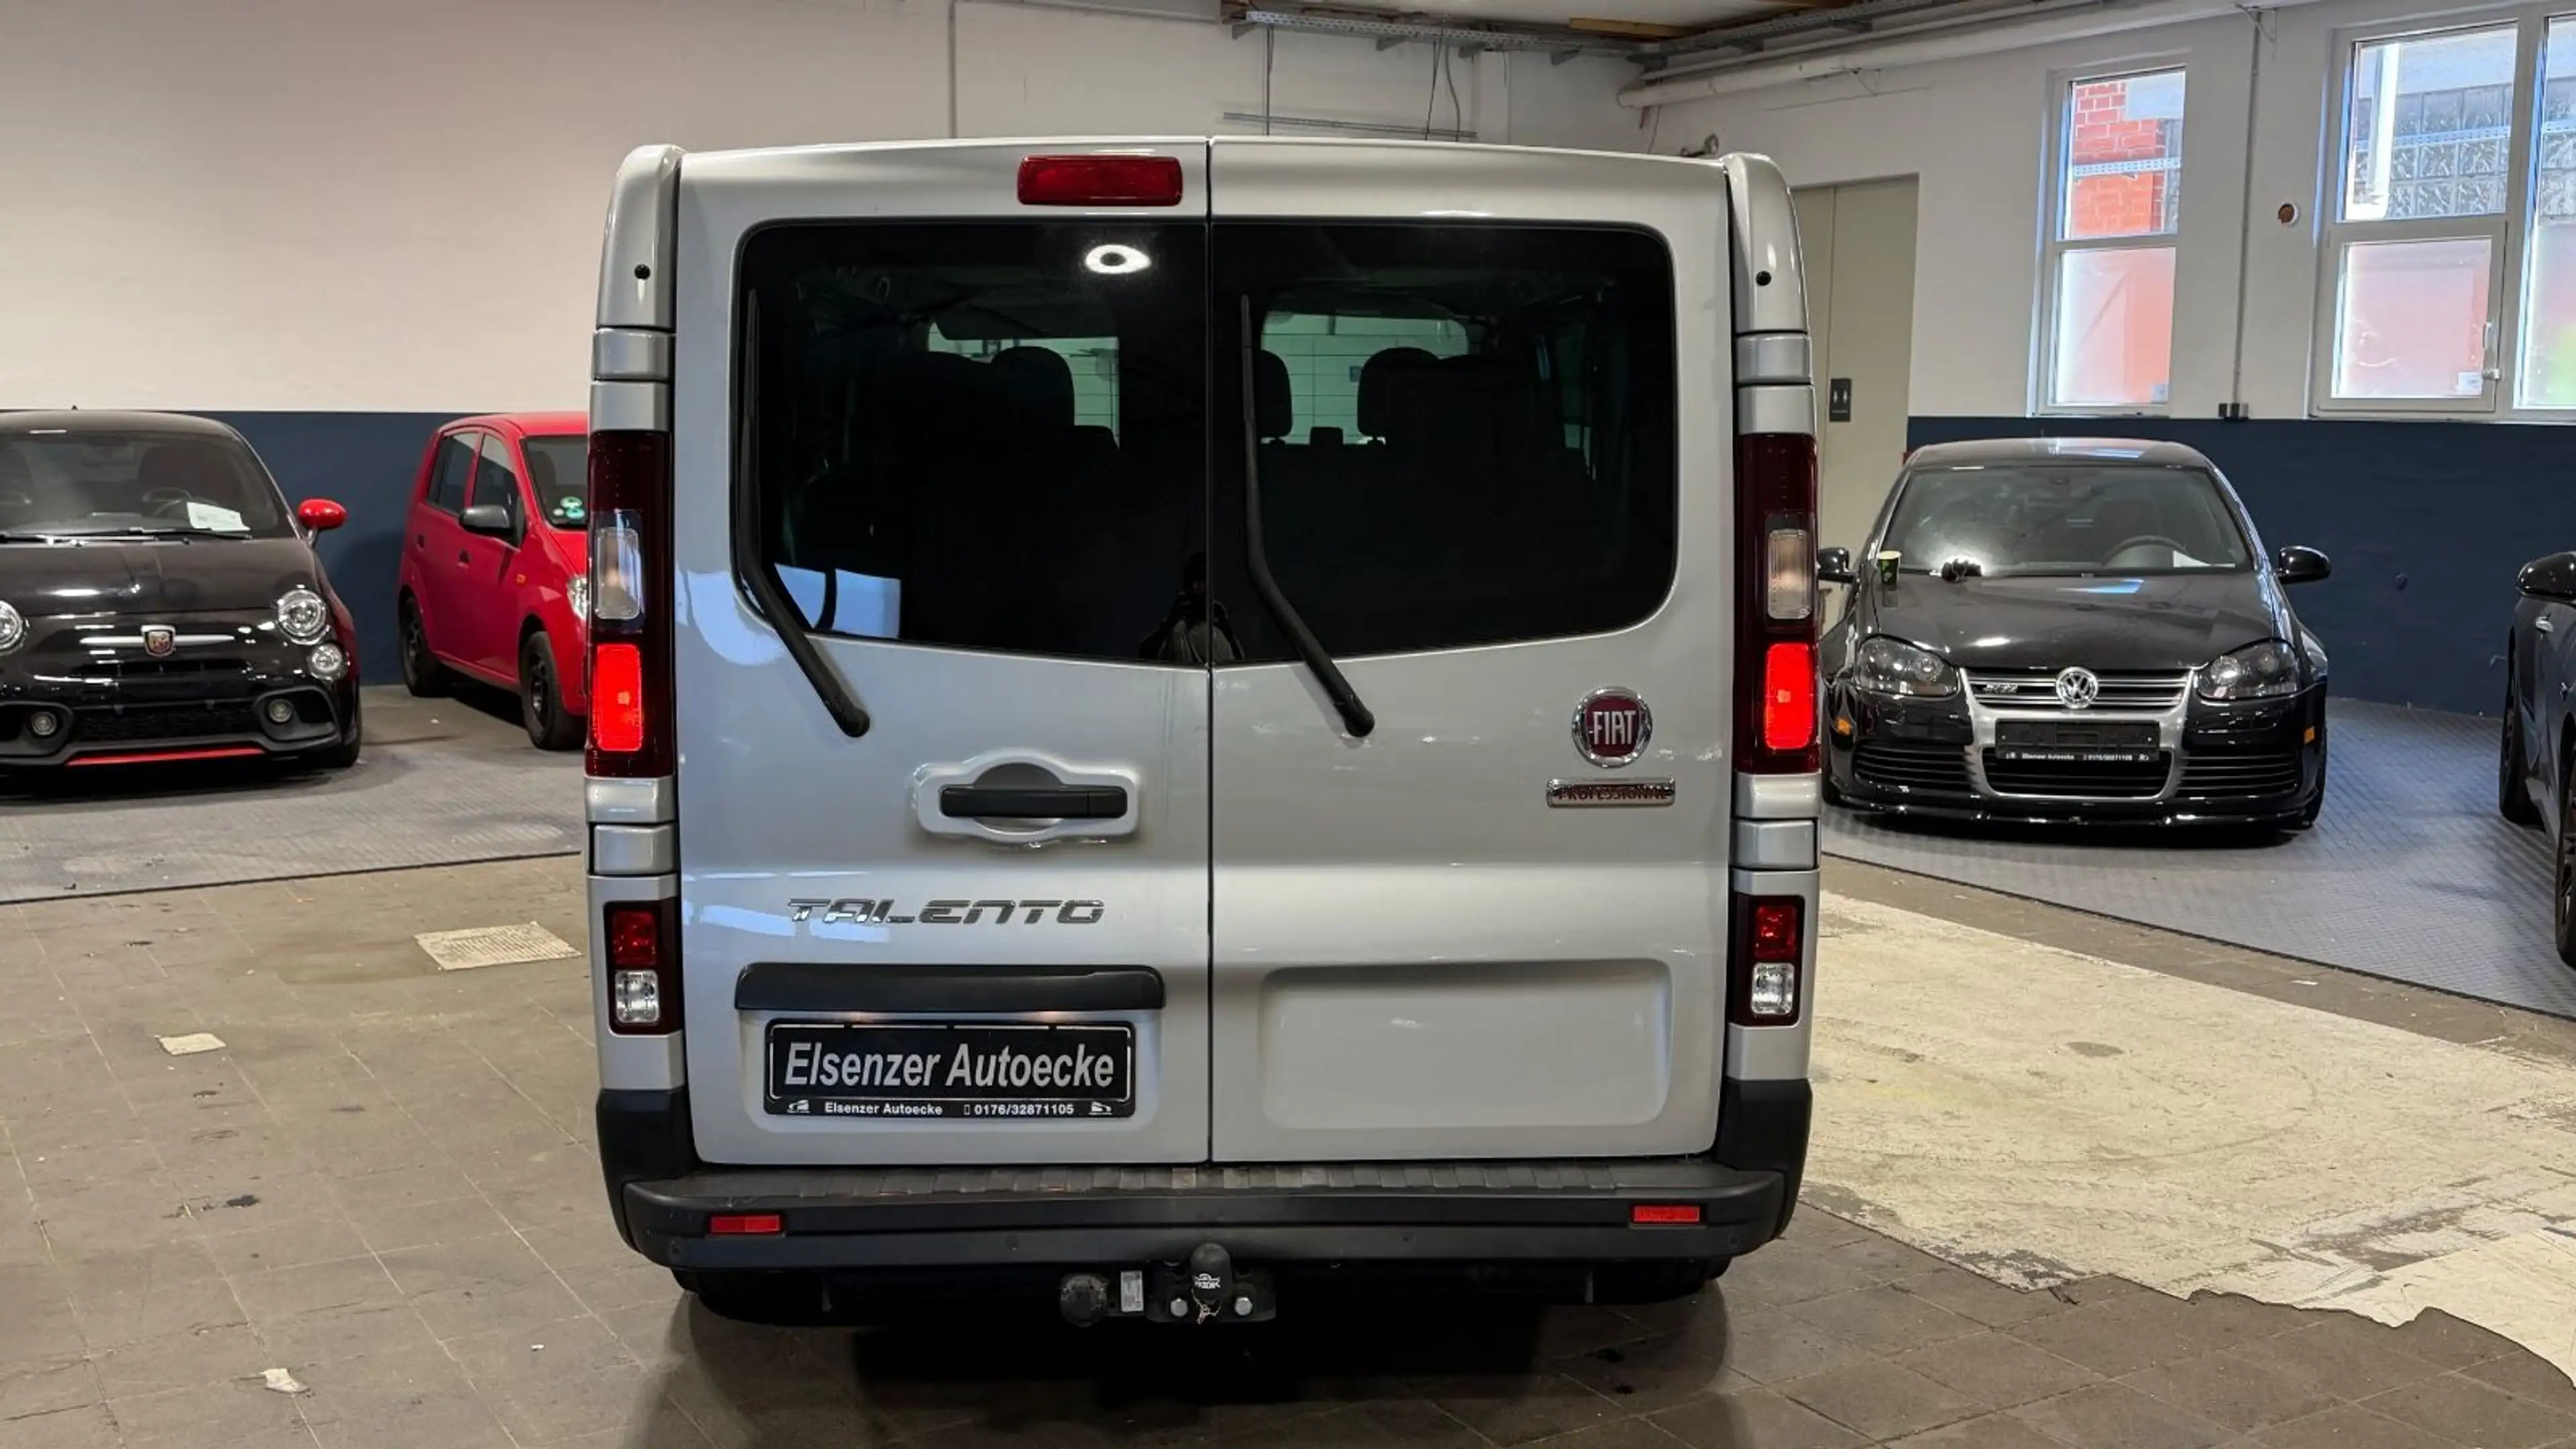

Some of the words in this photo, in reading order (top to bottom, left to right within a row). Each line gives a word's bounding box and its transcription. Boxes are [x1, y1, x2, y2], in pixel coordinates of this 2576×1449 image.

[1592, 710, 1636, 745] FIAT
[788, 898, 1104, 924] TALENTO
[785, 1042, 941, 1086] Elsenzer
[945, 1043, 1114, 1087] Autoecke
[824, 1101, 879, 1114] Elsenzer
[882, 1102, 943, 1115] Autoecke
[973, 1104, 1075, 1115] 0176/32871105
